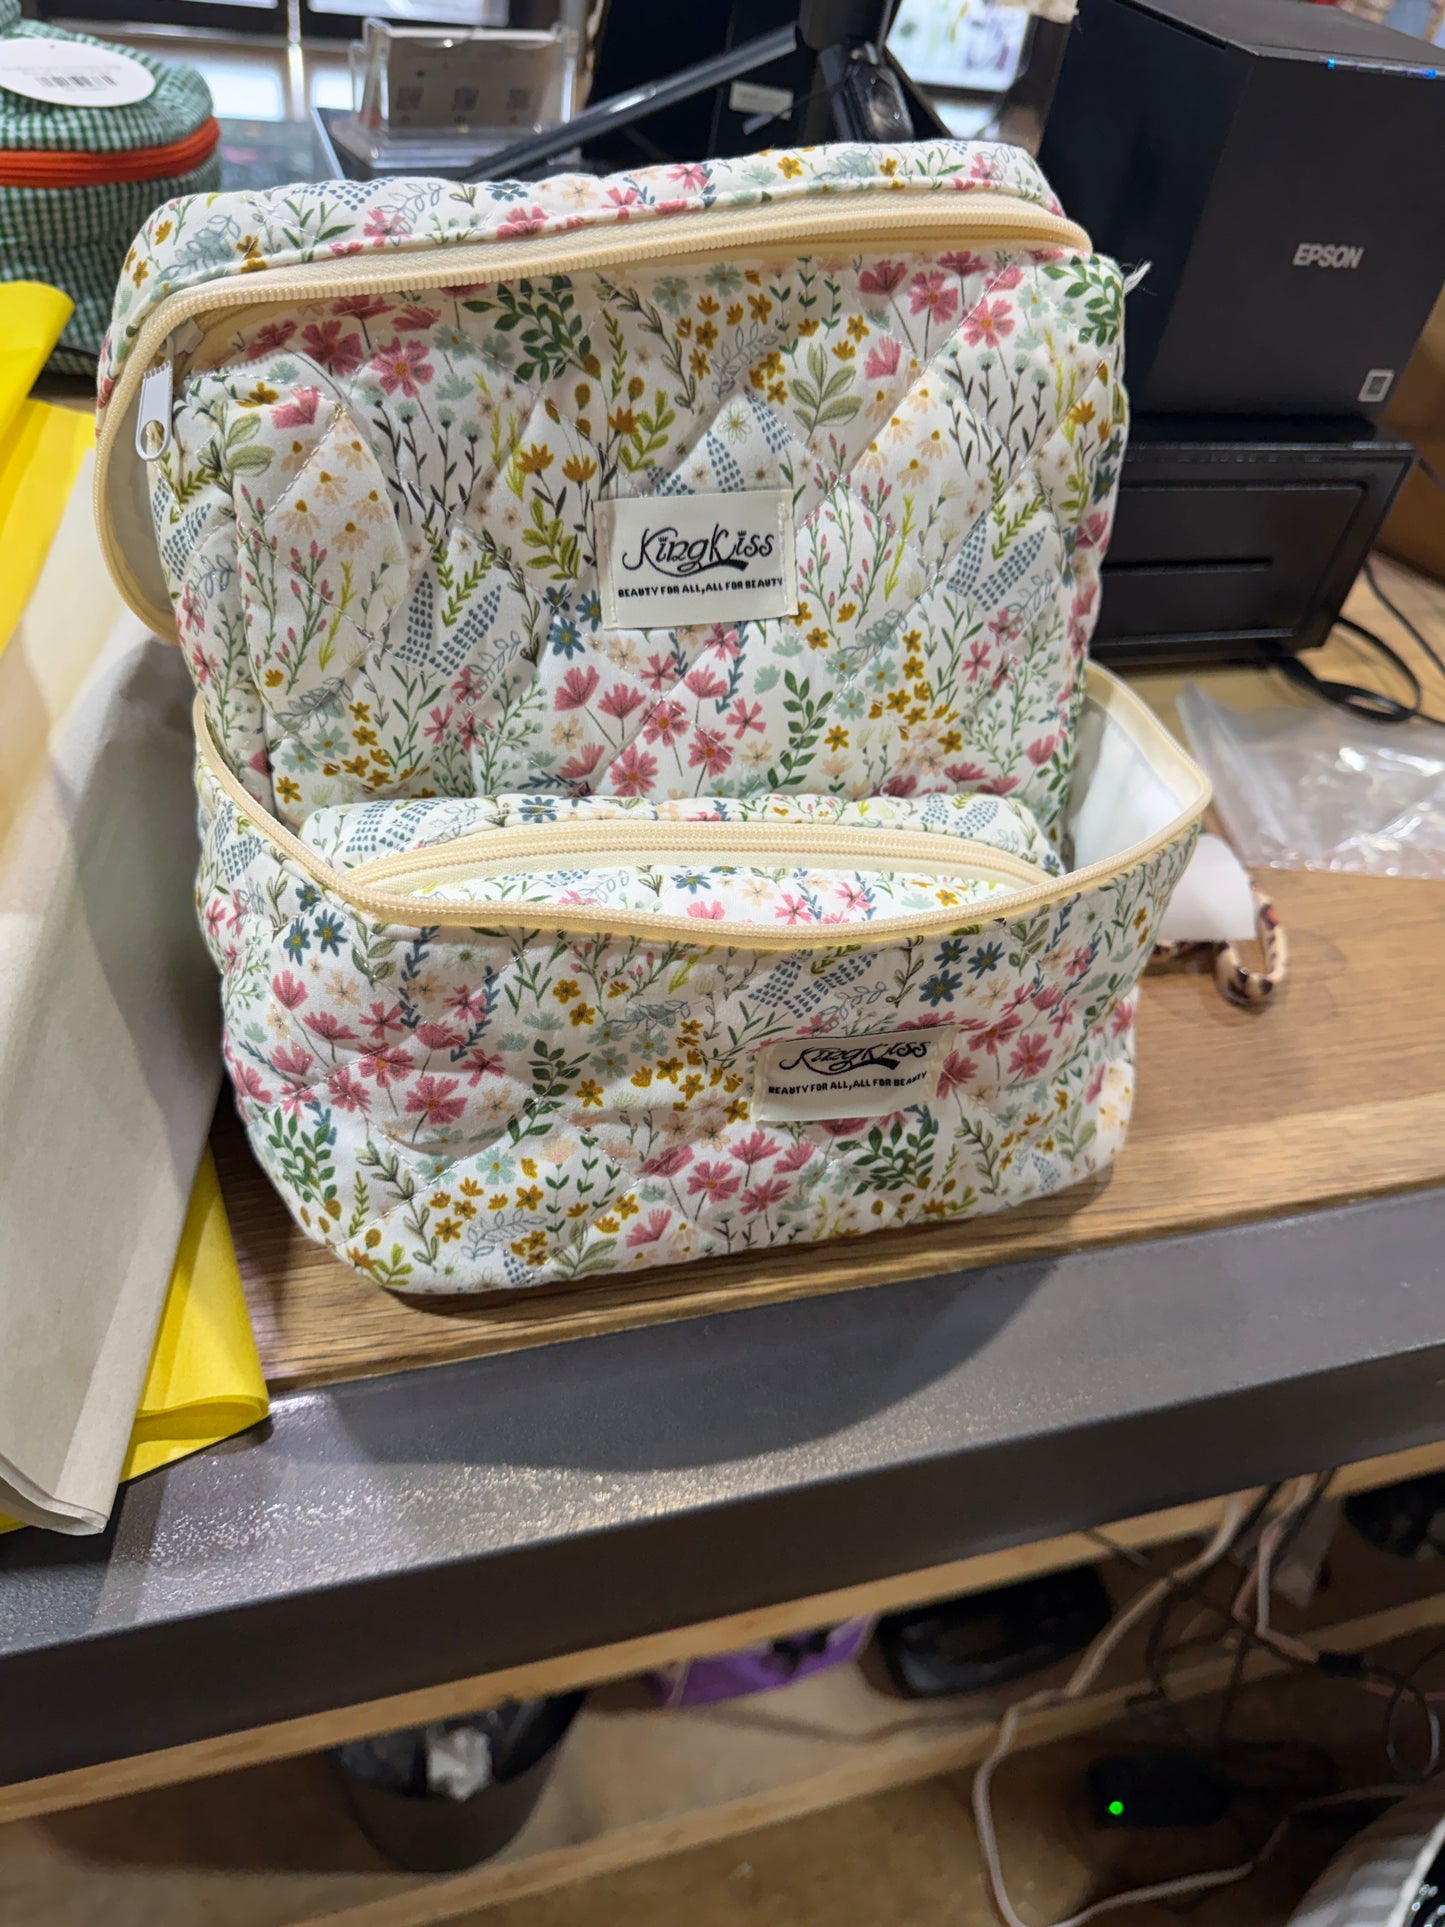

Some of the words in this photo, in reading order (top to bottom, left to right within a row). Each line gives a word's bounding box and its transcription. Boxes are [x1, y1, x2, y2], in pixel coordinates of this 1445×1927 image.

[1292, 242, 1364, 270] EPSON
[618, 586, 659, 598] BEAUTY
[661, 586, 679, 595] FOR
[725, 581, 744, 590] FOR
[745, 577, 783, 589] BEAUTY
[768, 1085, 809, 1094] BEAUTY
[810, 1083, 828, 1092] FOR
[872, 1079, 891, 1088] FOR
[893, 1071, 928, 1086] BEAUTY
